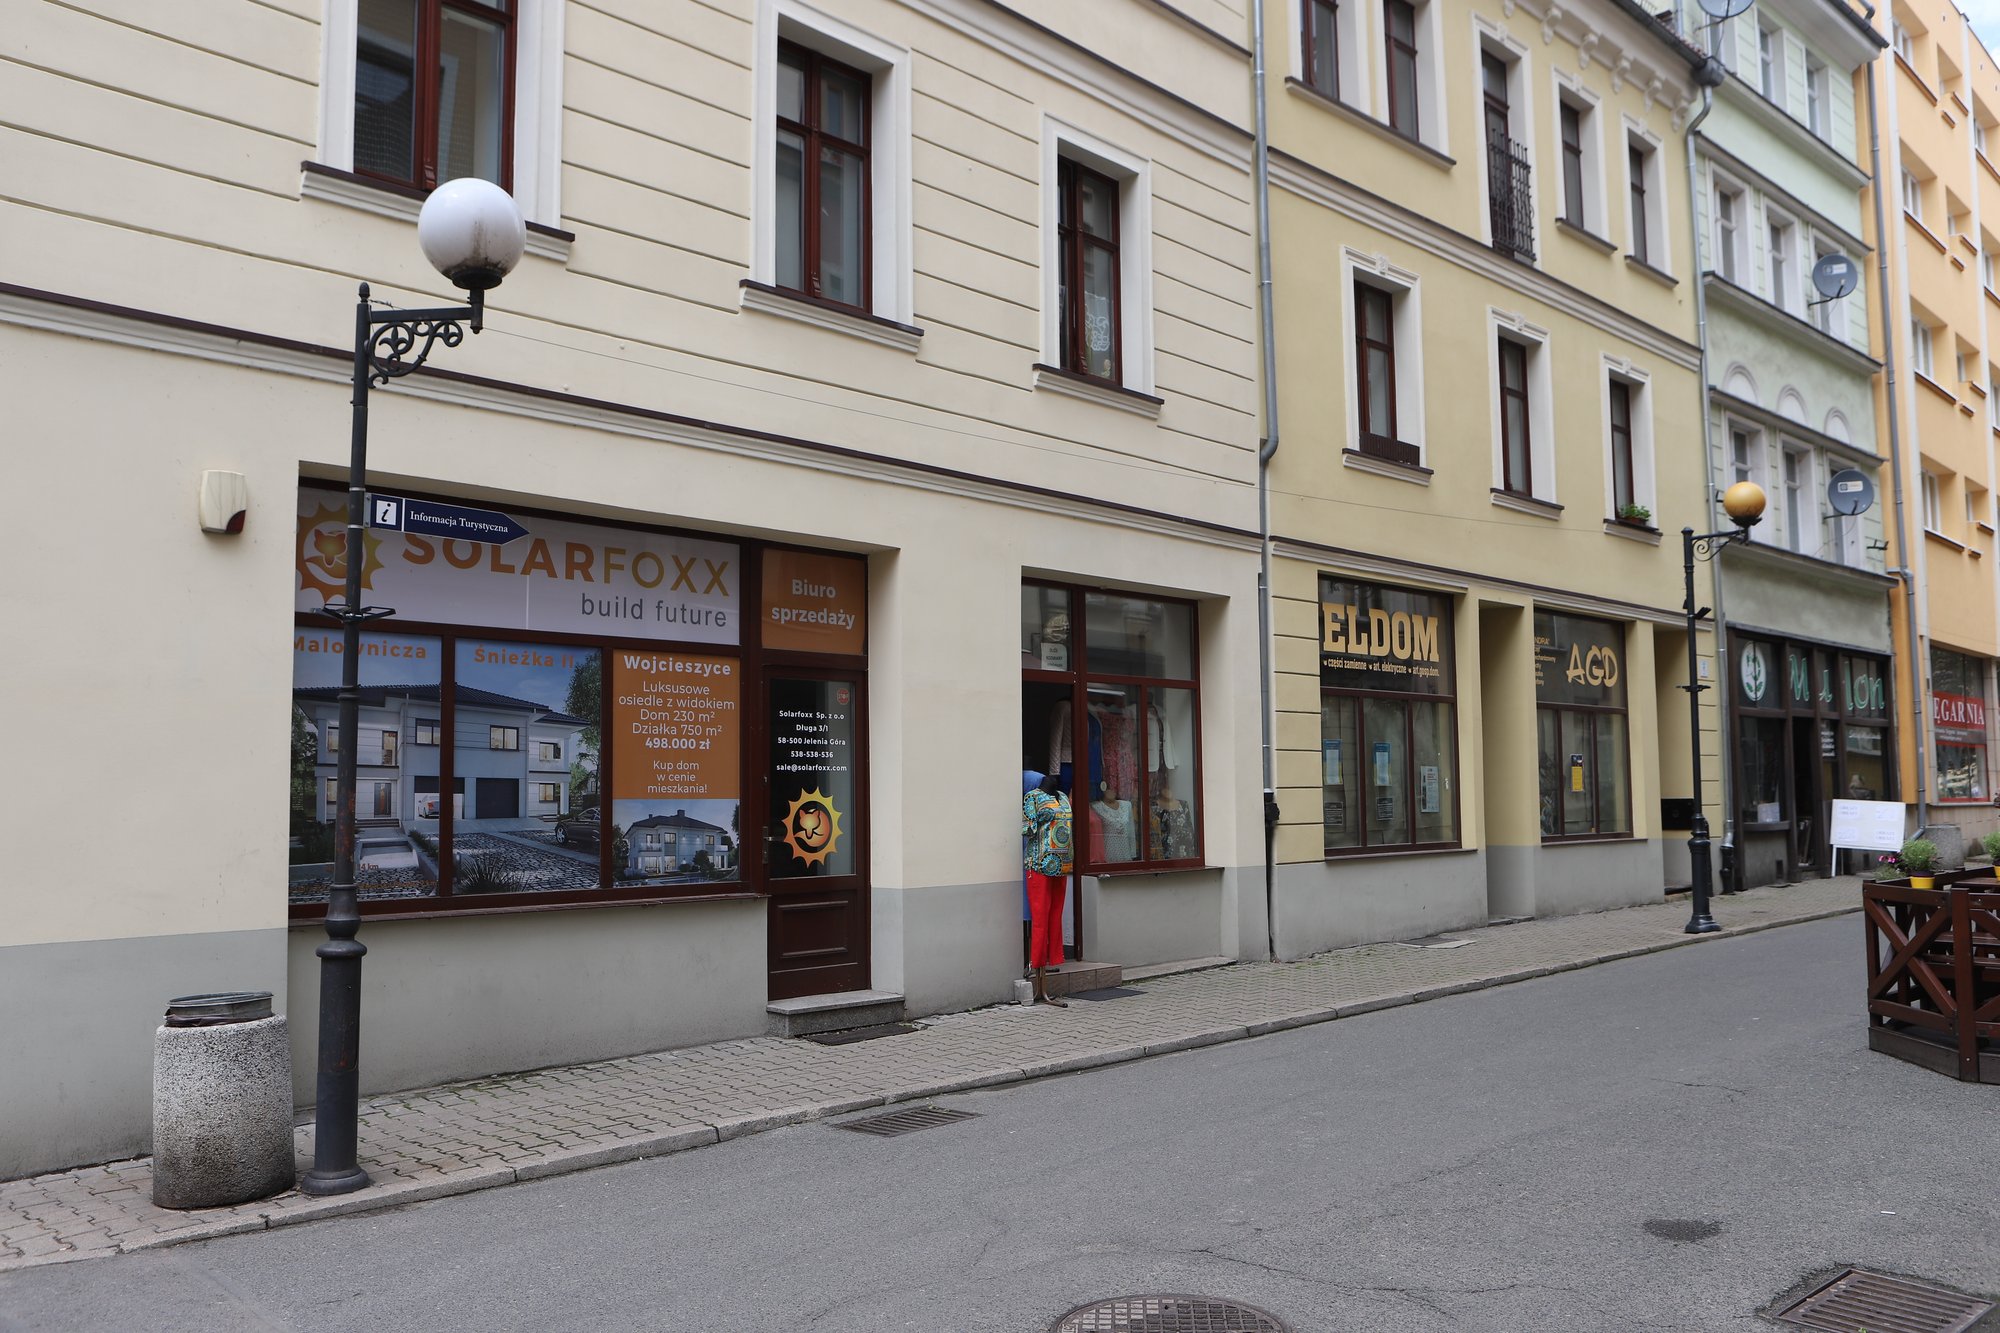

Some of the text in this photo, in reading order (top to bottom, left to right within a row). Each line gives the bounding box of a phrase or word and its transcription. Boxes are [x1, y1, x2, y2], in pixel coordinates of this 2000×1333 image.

[410, 511, 457, 527] Informacja
[458, 517, 509, 533] Turystyczna
[402, 534, 730, 597] SOLARFOXX
[791, 579, 837, 598] Biuro
[581, 593, 727, 627] build future
[771, 607, 856, 630] sprzedaży
[1322, 601, 1440, 662] ELDOM
[474, 644, 555, 667] Śnieżka
[623, 655, 732, 677] Wojcieszyce
[1327, 657, 1344, 670] części
[1344, 658, 1367, 671] zamienne
[1381, 661, 1407, 675] elektryczne
[1566, 642, 1618, 687] AGD
[643, 681, 710, 695] Luksusowe
[618, 693, 735, 710] osiedle z widokiem
[640, 709, 670, 721] Dom
[673, 710, 695, 722] 230
[779, 710, 813, 718] Solarfoxx
[816, 711, 827, 720] Sp.
[632, 722, 677, 735] Działka
[680, 724, 703, 736] 750
[645, 737, 711, 750] 498.000 zł
[803, 737, 828, 745] Jelenia
[829, 738, 846, 746] Góra
[790, 750, 834, 758] 538-538-536
[653, 760, 700, 771] Kup dom
[776, 763, 848, 773] sale@solarfoxx.com
[656, 772, 696, 782] w cenie
[647, 784, 708, 793] mieszkania!
